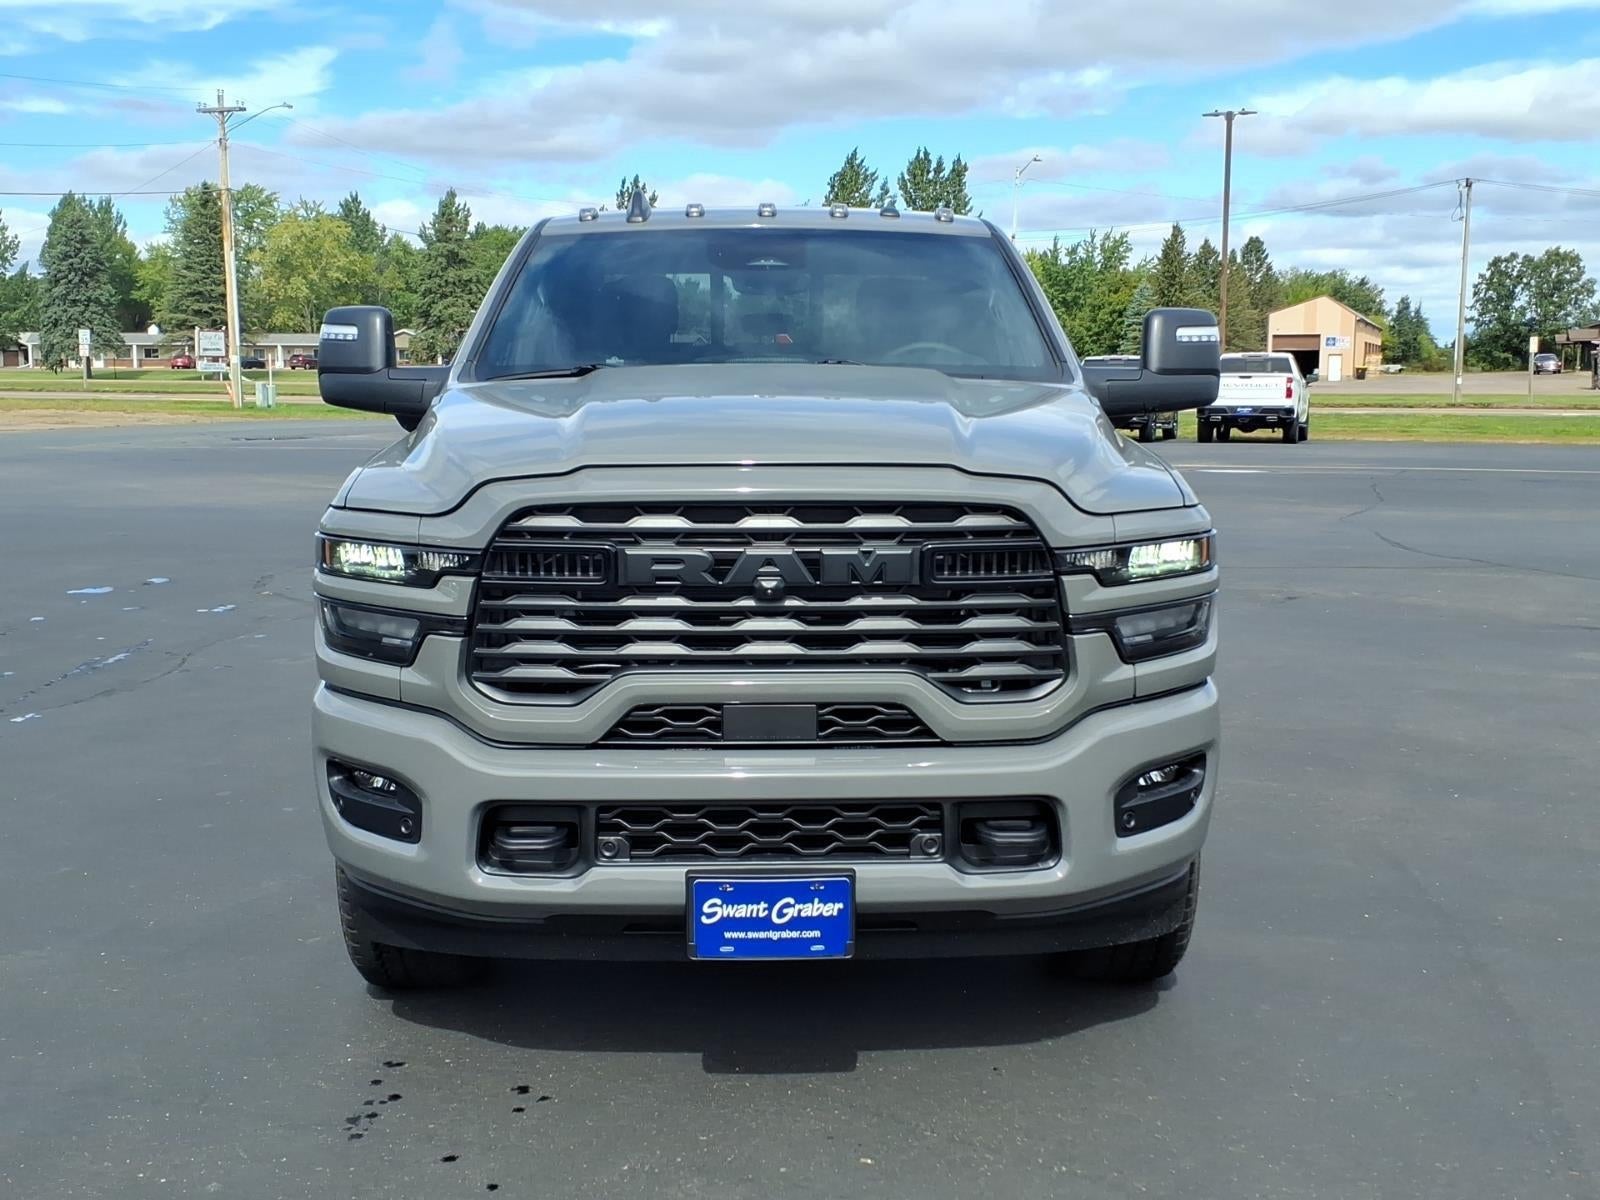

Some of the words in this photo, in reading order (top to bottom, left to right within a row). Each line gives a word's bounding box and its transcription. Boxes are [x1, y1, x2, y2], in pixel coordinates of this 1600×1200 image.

[620, 548, 918, 585] RAM
[700, 898, 769, 924] Swant
[771, 897, 844, 924] Graber
[723, 929, 821, 941] www.swantgraber.com
